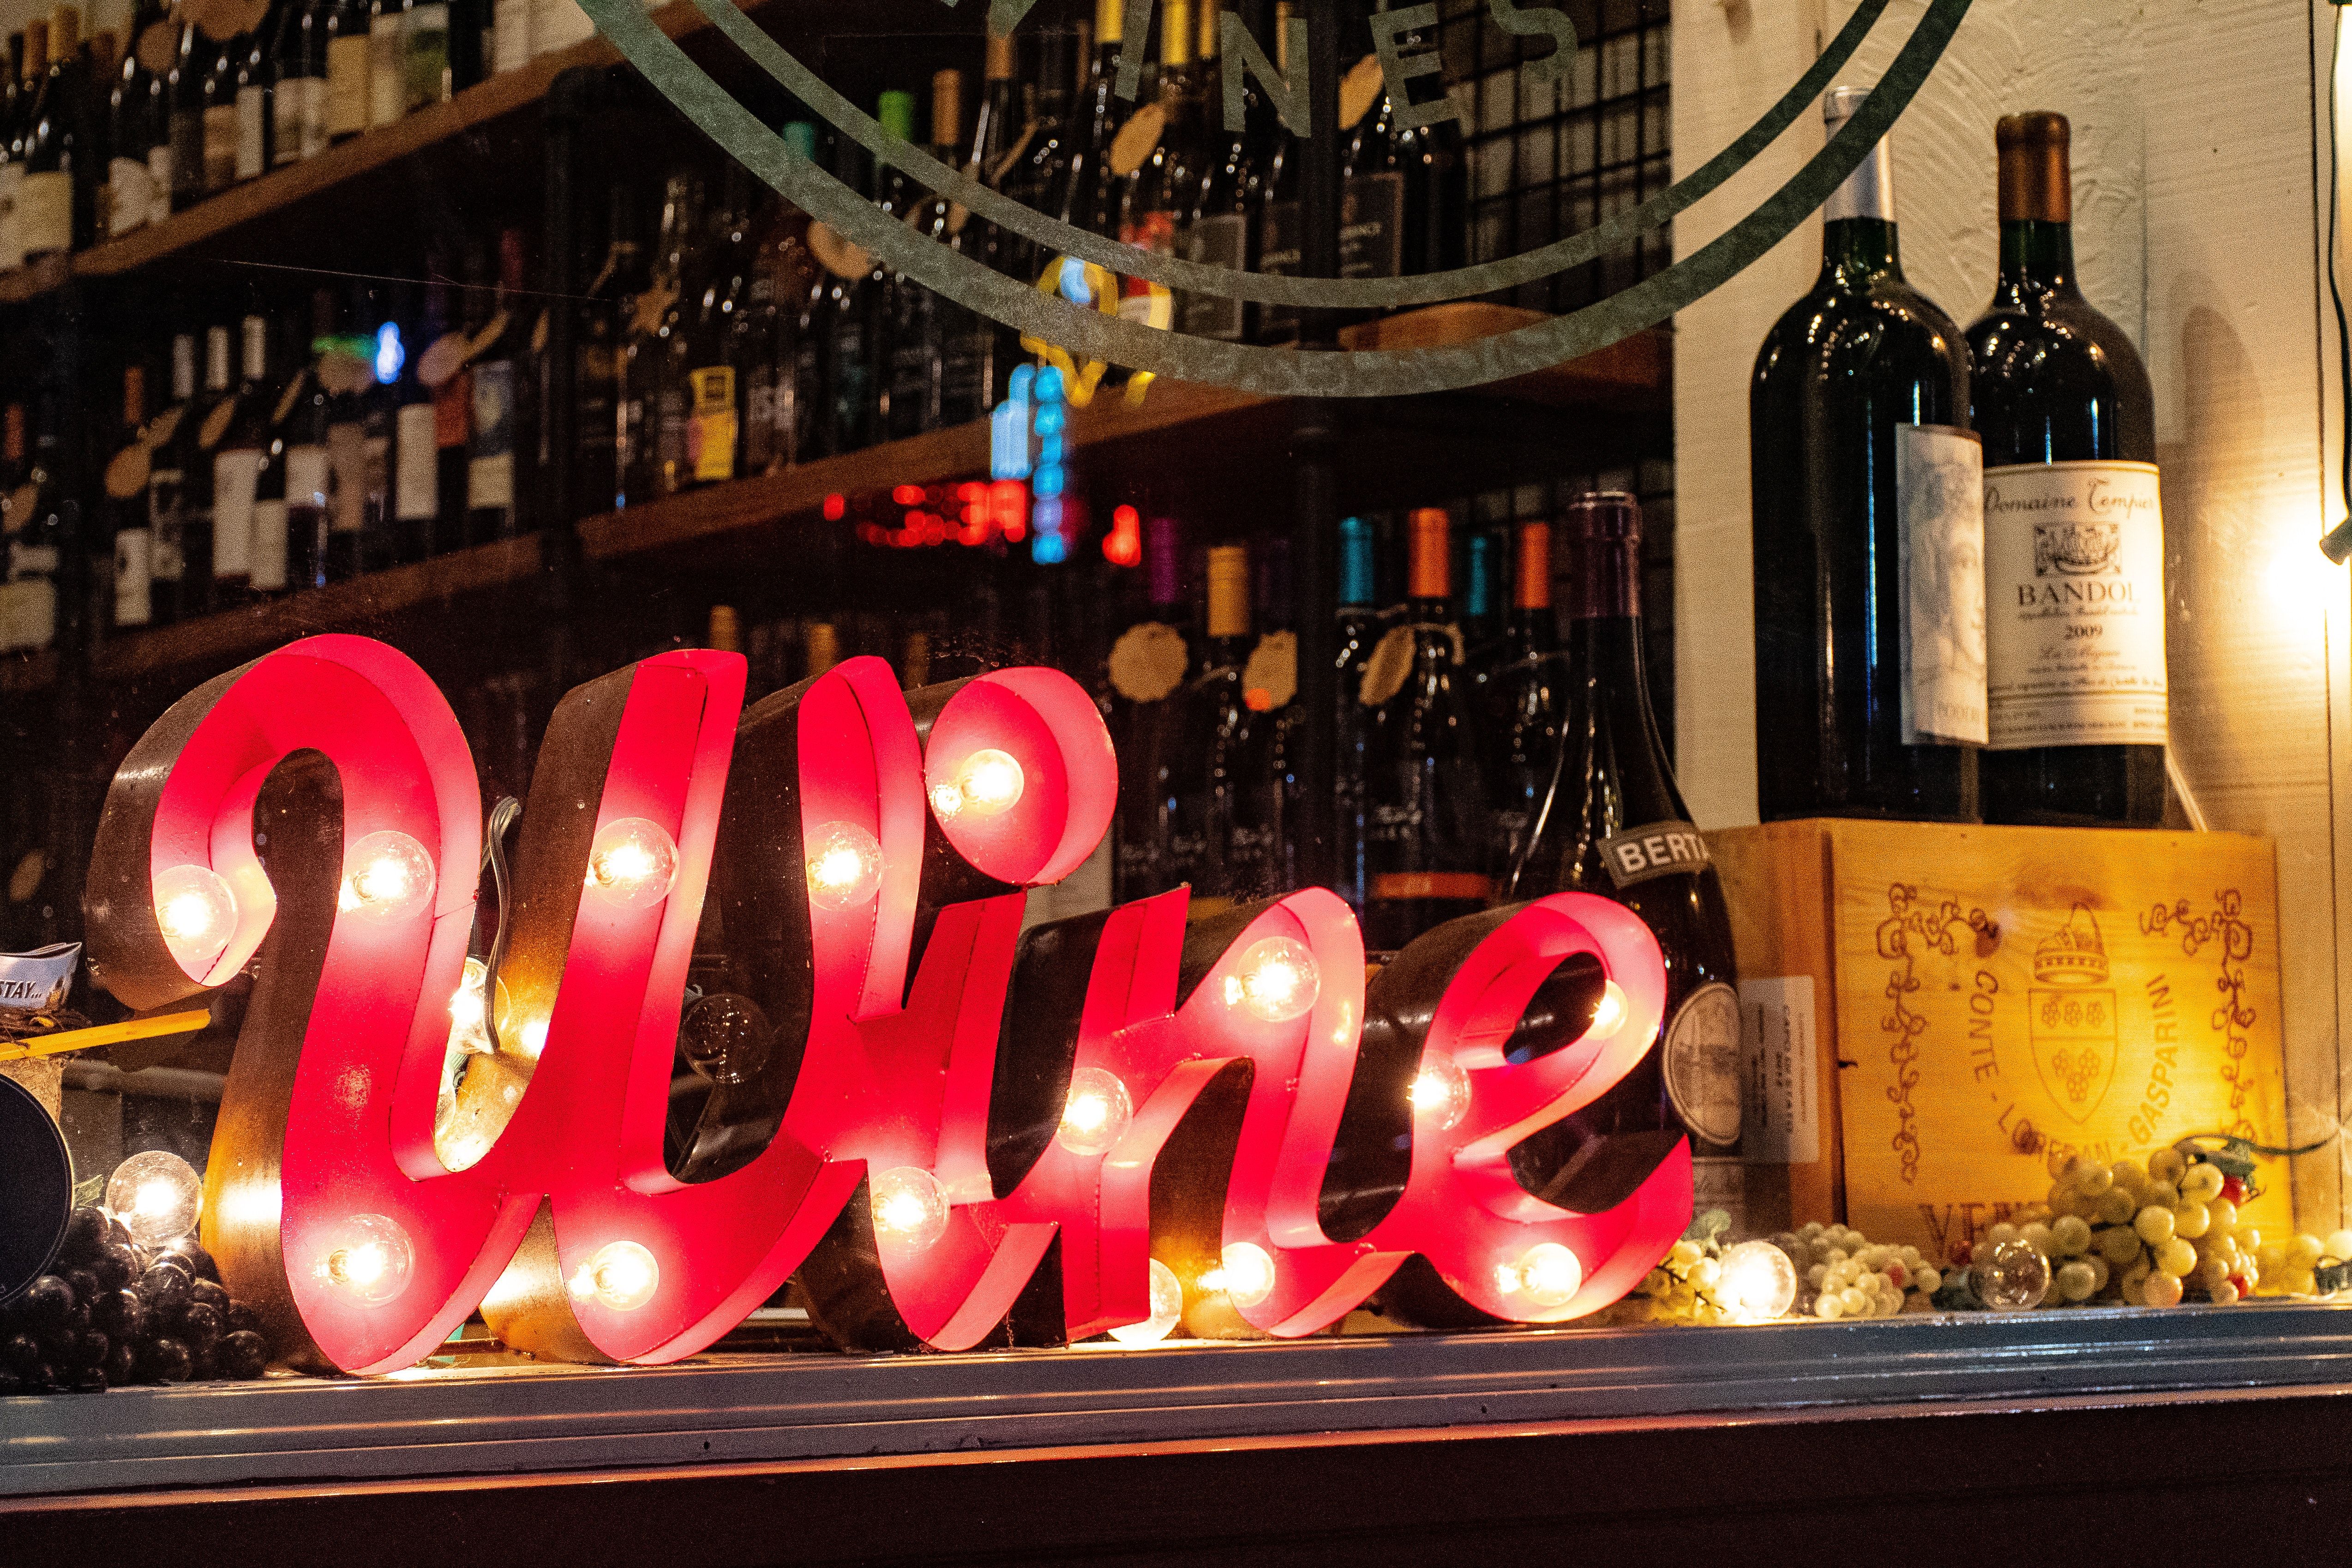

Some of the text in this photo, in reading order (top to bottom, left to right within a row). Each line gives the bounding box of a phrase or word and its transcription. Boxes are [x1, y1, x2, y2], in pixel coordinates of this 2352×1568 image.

[935, 0, 1579, 138] INES
[2017, 581, 2139, 606] BANDOL
[2064, 623, 2103, 640] 2009
[0, 979, 42, 999] TAY...
[87, 631, 1693, 1375] Wine
[1969, 970, 1999, 1082] CONTE
[2128, 973, 2178, 1145] GASPARINI
